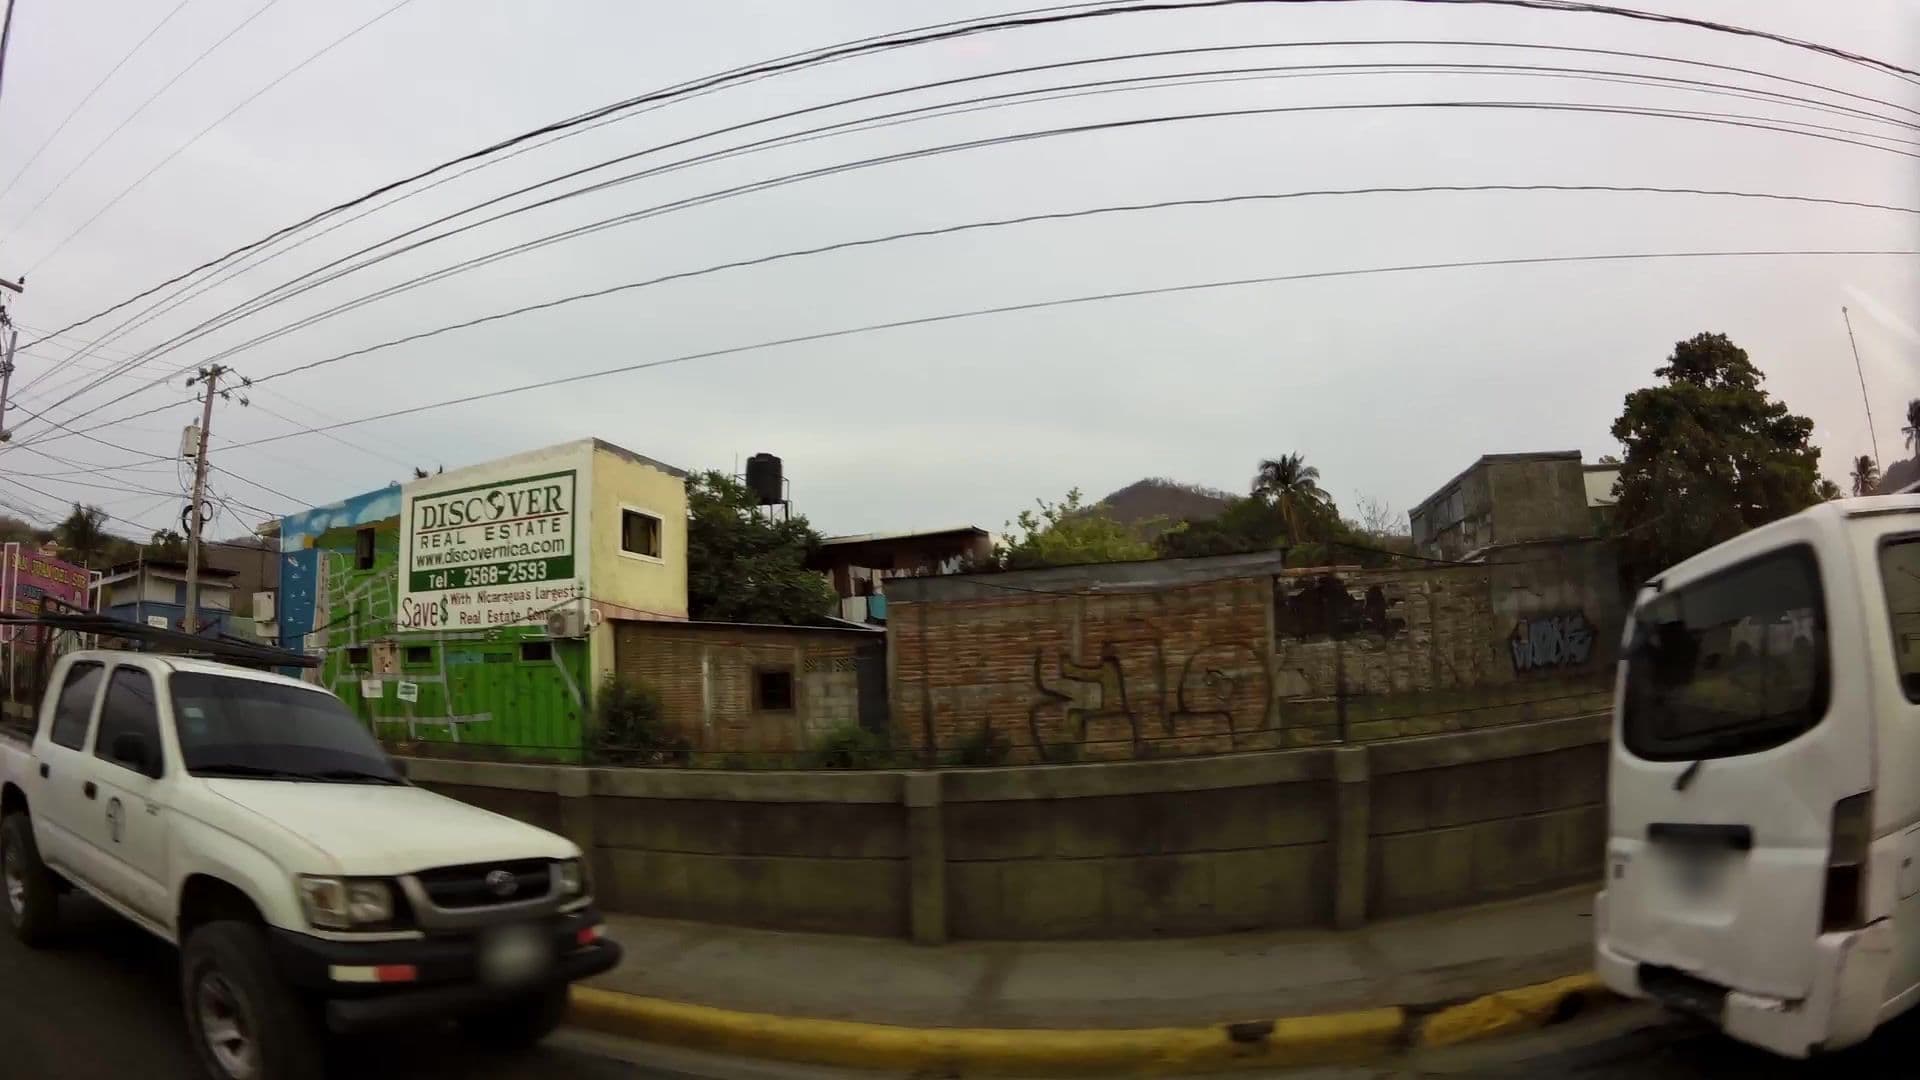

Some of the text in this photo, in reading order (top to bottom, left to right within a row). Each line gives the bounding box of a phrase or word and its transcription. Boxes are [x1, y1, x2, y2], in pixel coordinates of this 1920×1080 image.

[421, 484, 565, 530] DISCOVER
[420, 517, 561, 549] REAL ESTATE
[464, 560, 547, 586] 2568-2593
[451, 592, 472, 606] With
[459, 611, 481, 625] Real
[487, 608, 521, 624] Estate
